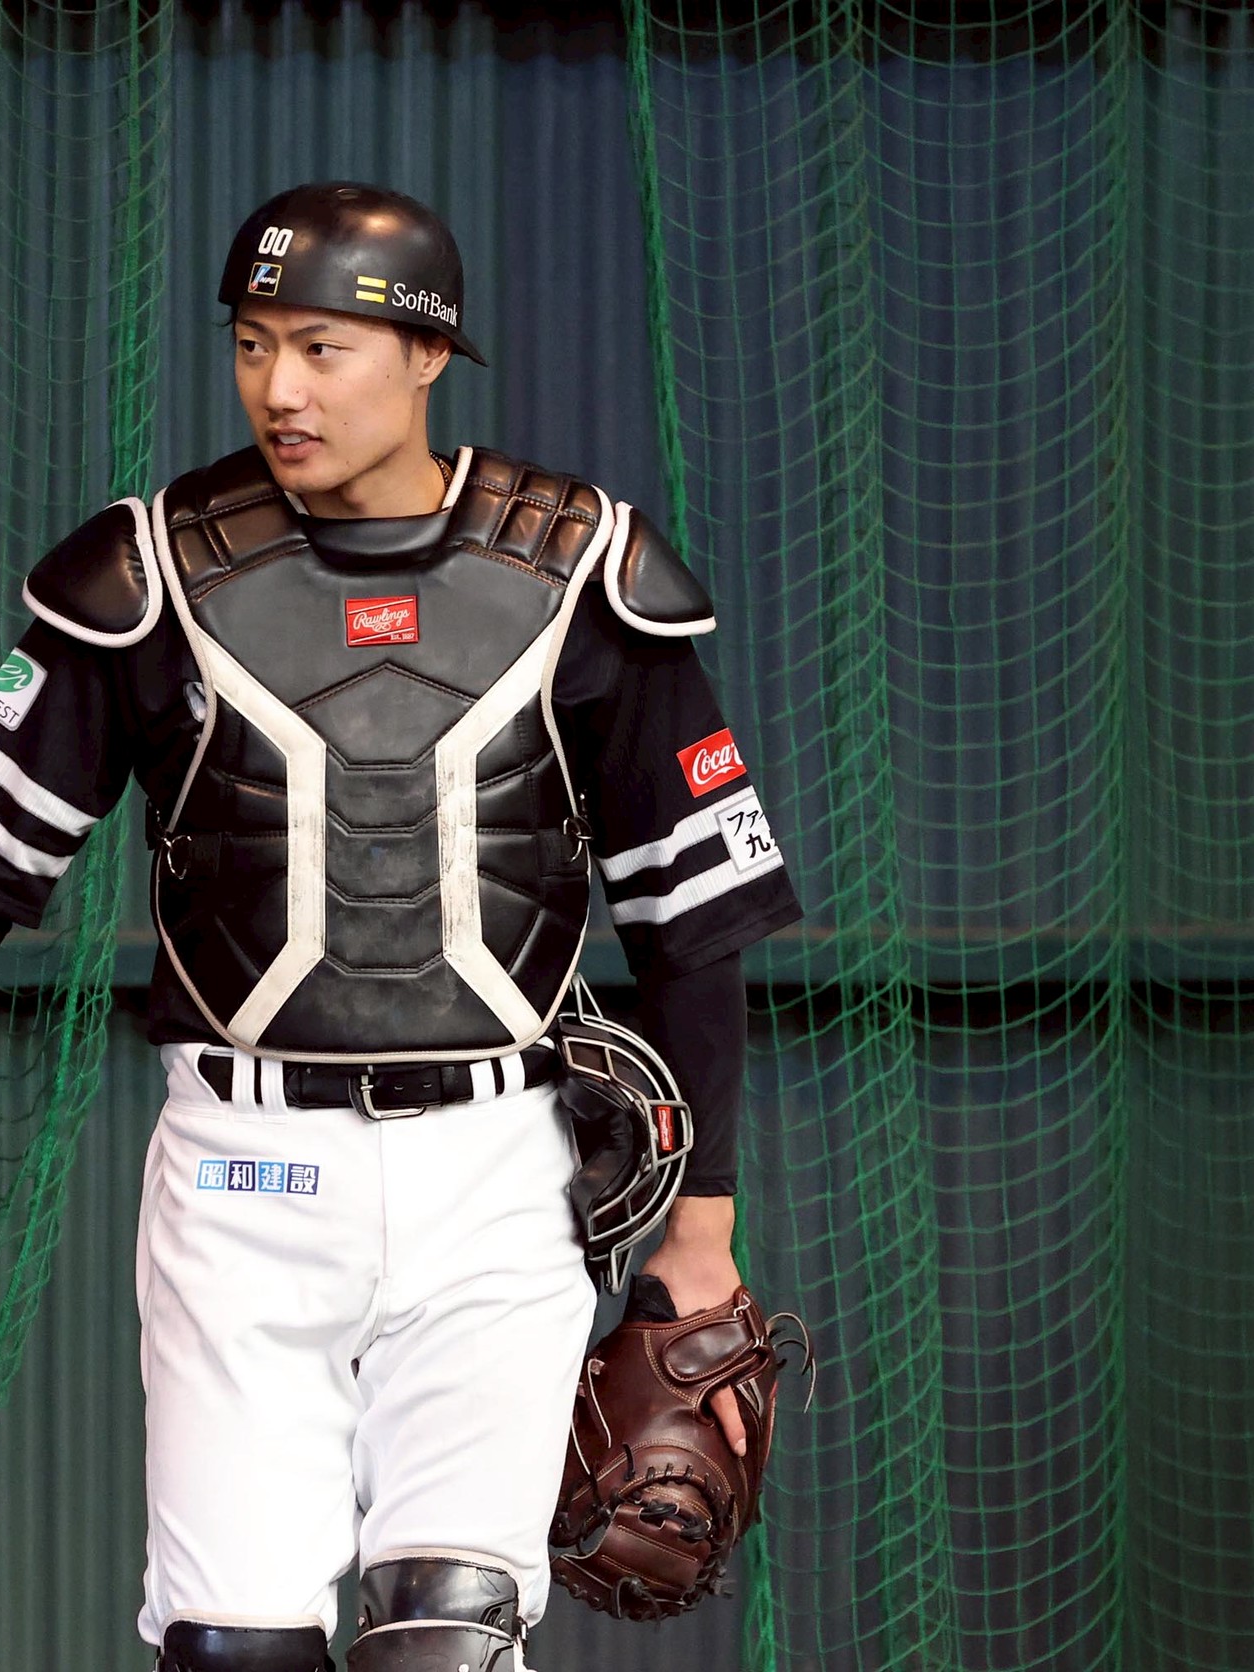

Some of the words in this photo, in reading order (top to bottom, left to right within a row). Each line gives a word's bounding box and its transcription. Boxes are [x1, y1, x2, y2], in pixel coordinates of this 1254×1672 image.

[258, 226, 294, 257] 00
[392, 283, 458, 328] SoftBank
[353, 608, 410, 630] Rawlings
[746, 833, 777, 858] 九
[197, 1161, 319, 1195] 昭和建設
